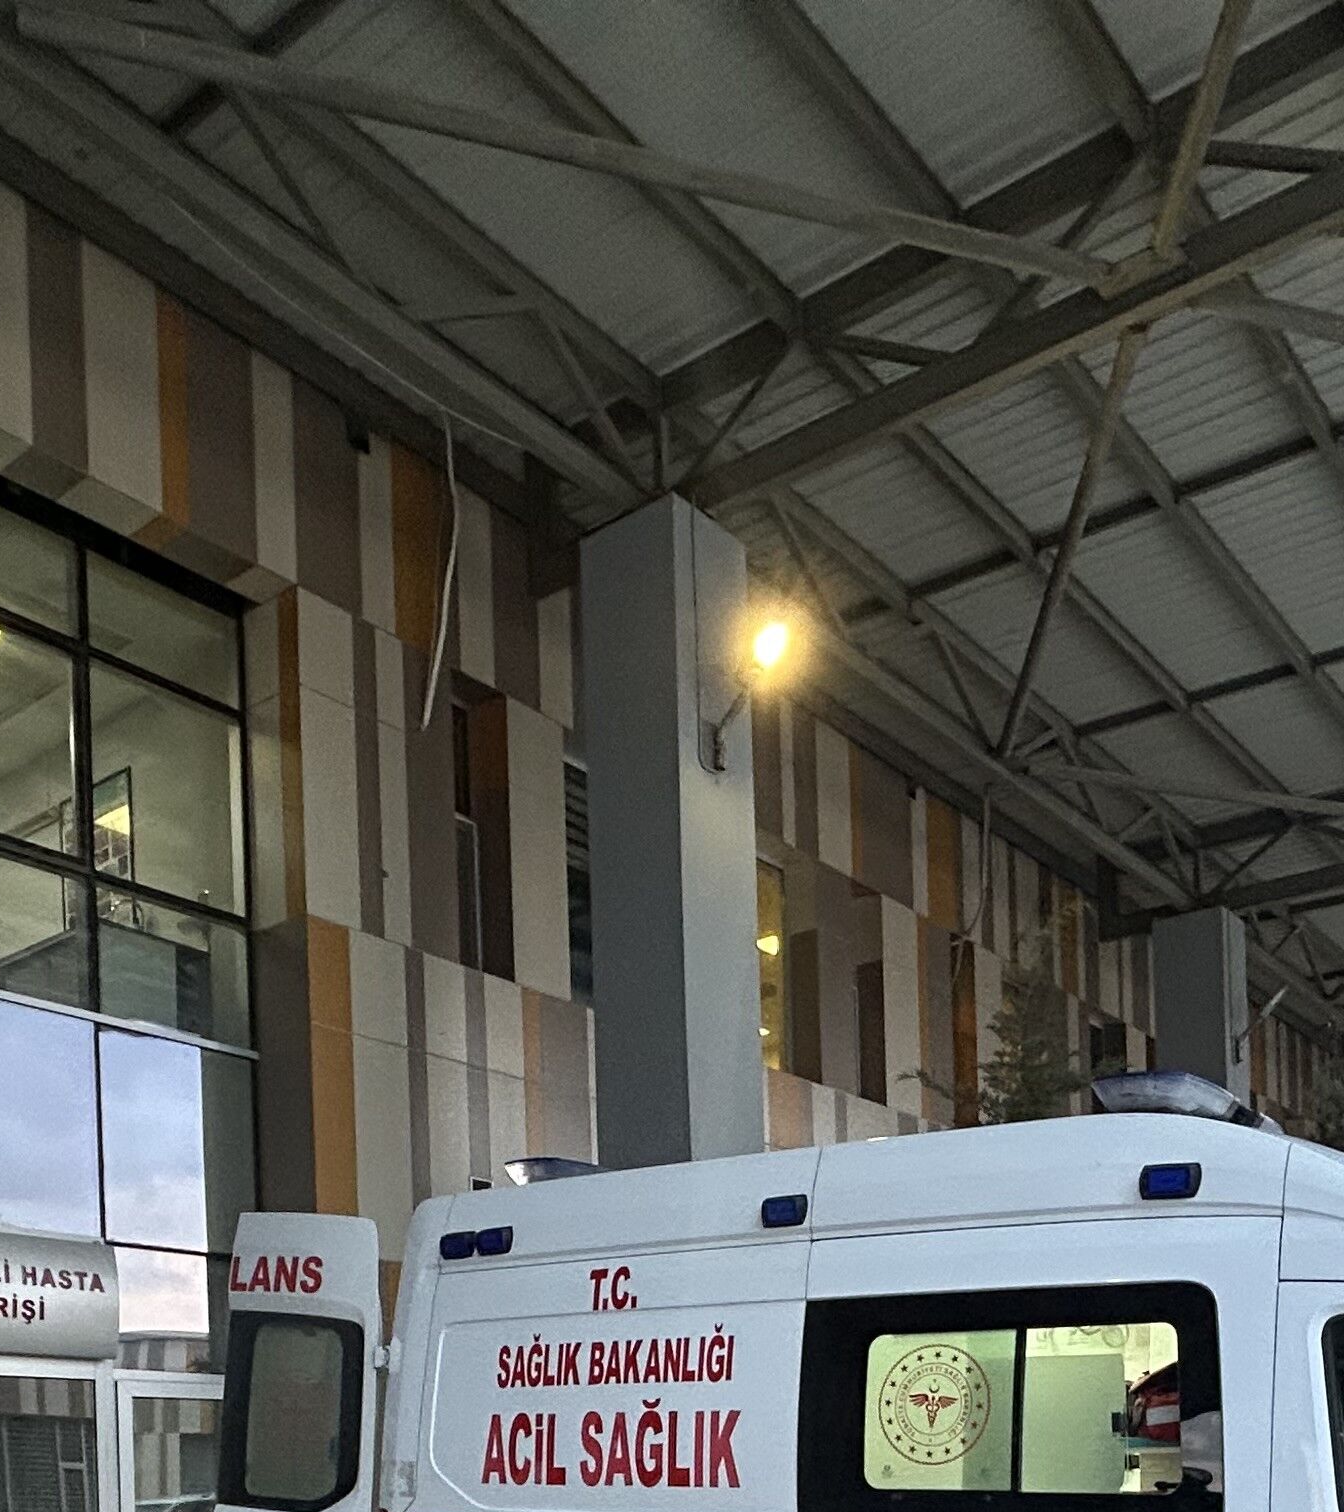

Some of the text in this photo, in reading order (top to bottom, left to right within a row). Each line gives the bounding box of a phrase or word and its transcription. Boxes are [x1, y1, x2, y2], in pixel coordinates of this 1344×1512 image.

[21, 1264, 105, 1294] HASTA
[230, 1255, 324, 1294] LANS
[589, 1265, 639, 1312] T.C.
[496, 1322, 736, 1389] SAĞLIK BAKANLIĞI
[481, 1396, 742, 1489] ACİL SAĞLIK
